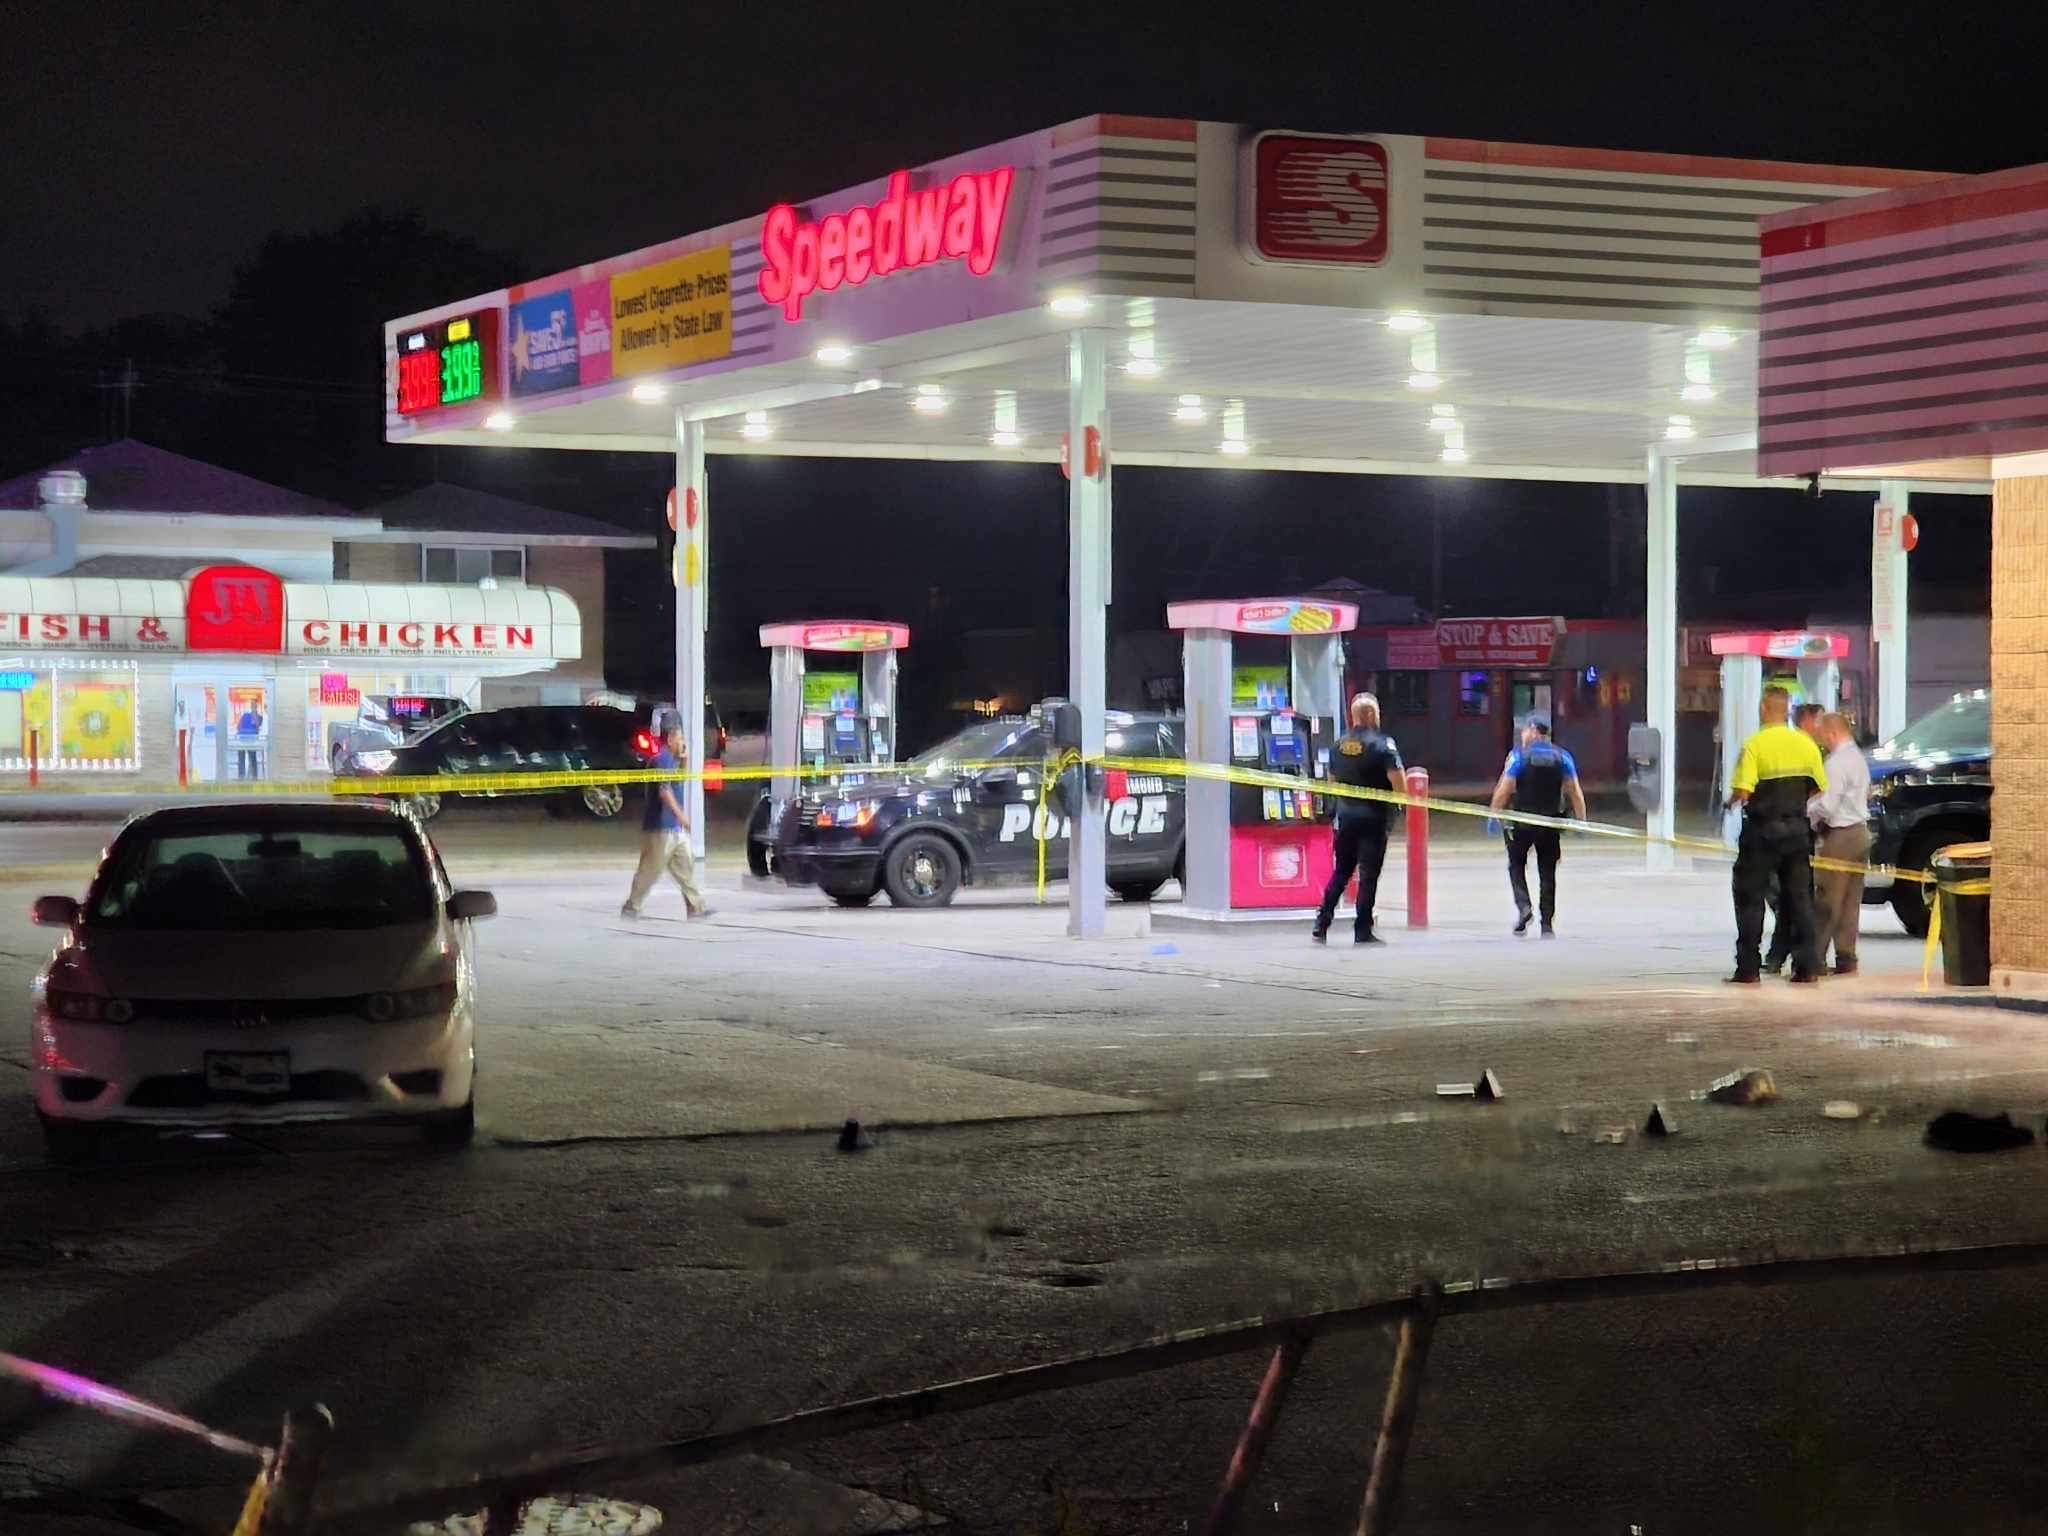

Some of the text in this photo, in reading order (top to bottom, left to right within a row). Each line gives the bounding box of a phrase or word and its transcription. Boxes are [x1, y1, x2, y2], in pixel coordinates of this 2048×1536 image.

[758, 166, 1014, 321] Speedway
[615, 271, 728, 319] Lowest Cigarette Prices
[621, 321, 658, 352] Allowed
[659, 318, 671, 349] by
[673, 314, 700, 339] State
[703, 311, 725, 334] Law
[137, 616, 169, 642] &
[303, 619, 534, 649] CHICKEN
[1440, 623, 1553, 647] STOP & SAVE
[1000, 796, 1167, 841] POCE
